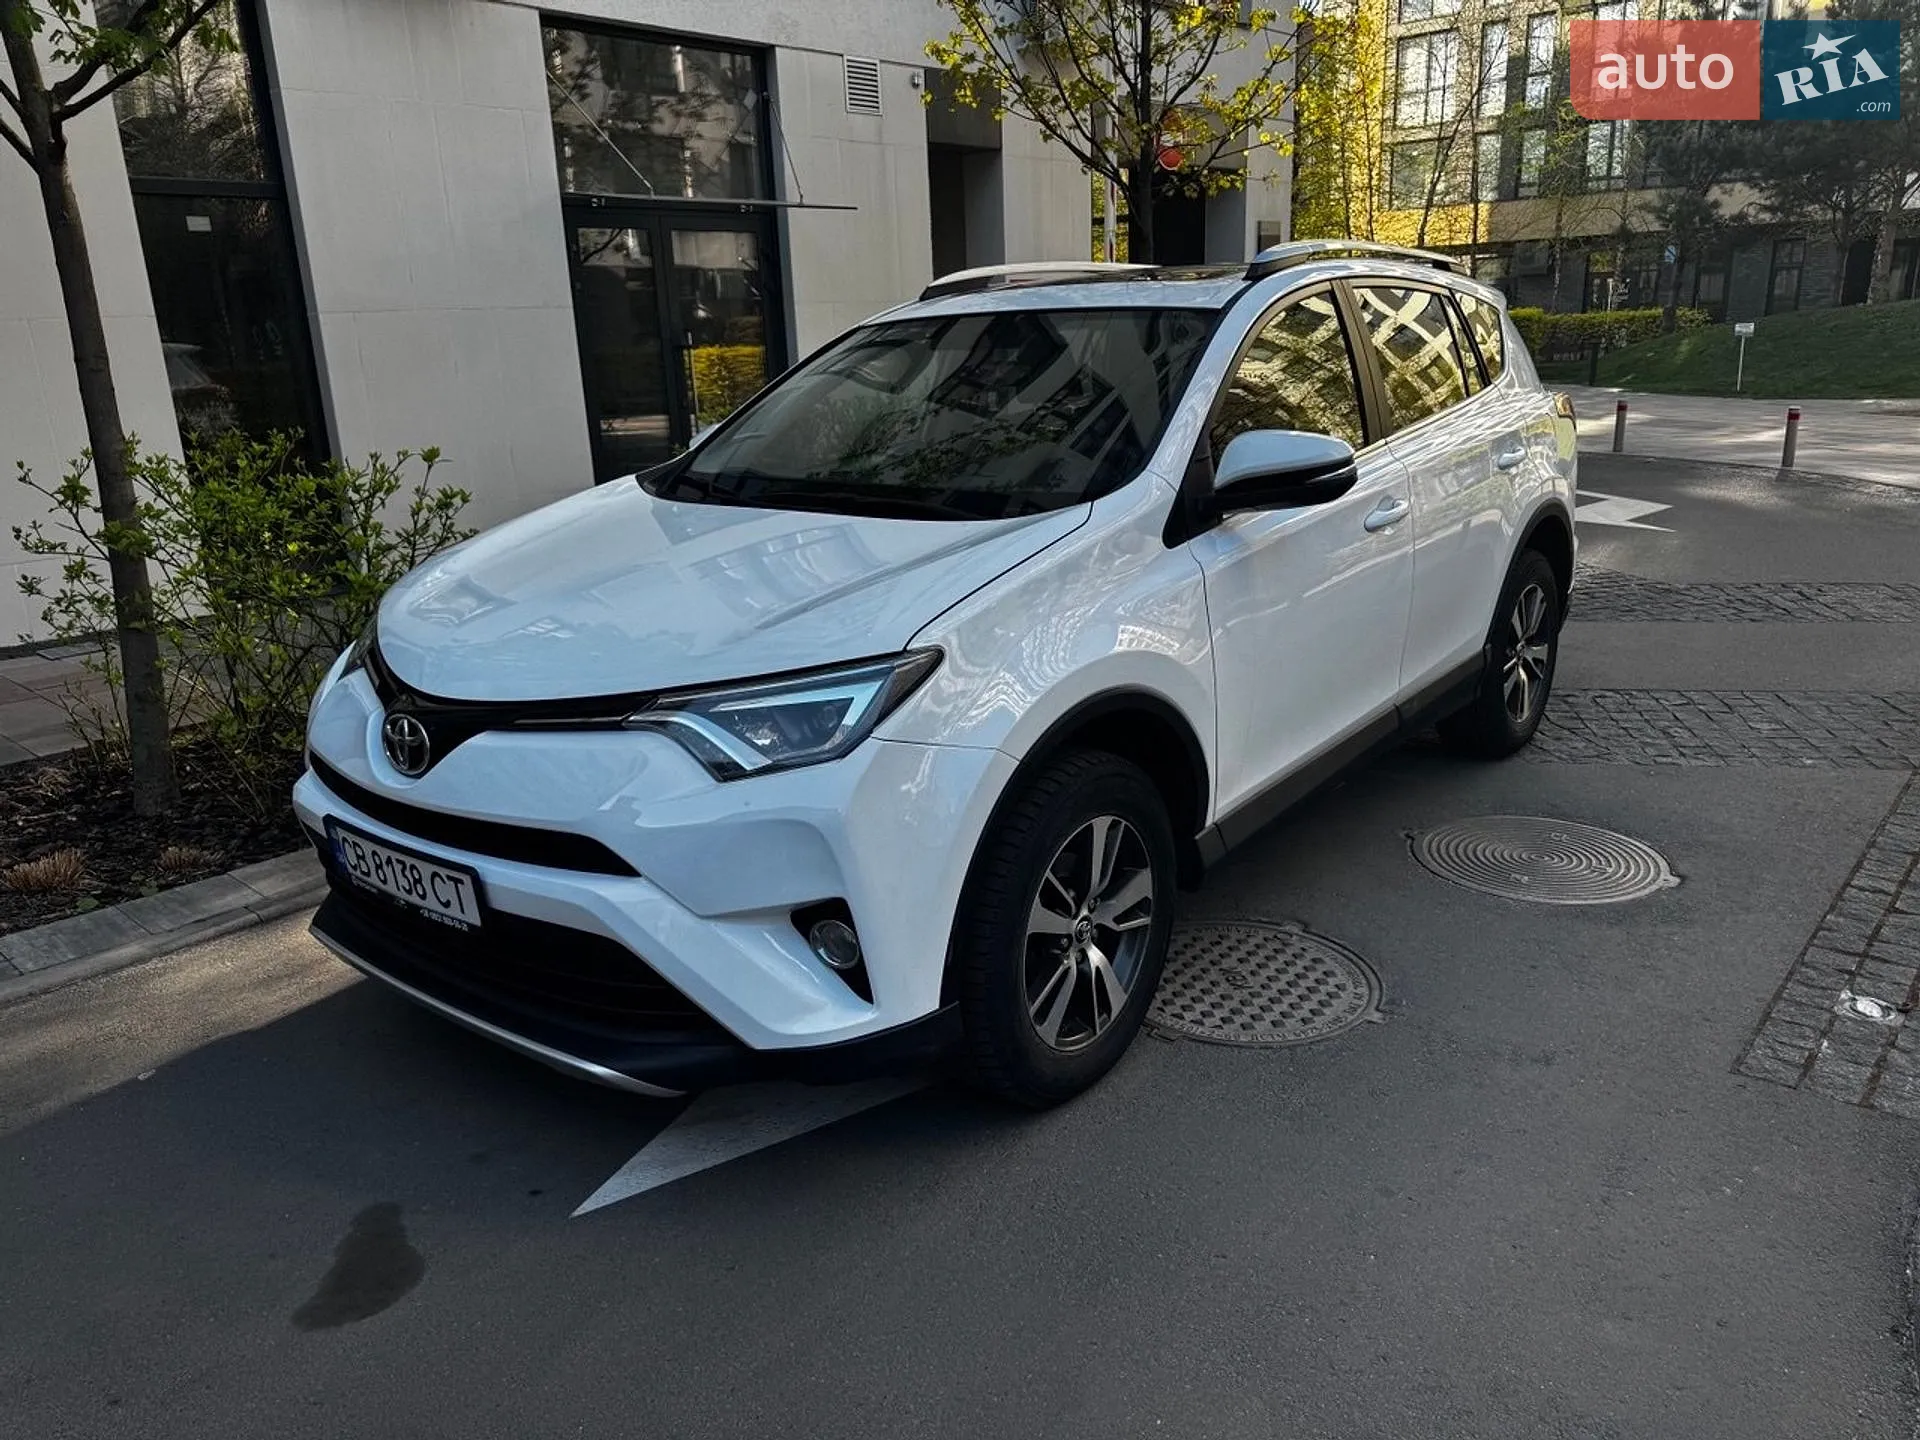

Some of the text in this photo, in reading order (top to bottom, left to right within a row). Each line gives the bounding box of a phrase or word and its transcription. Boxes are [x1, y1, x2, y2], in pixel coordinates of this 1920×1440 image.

[341, 836, 371, 878] CB
[371, 850, 427, 900] 8138
[430, 871, 465, 915] CT
